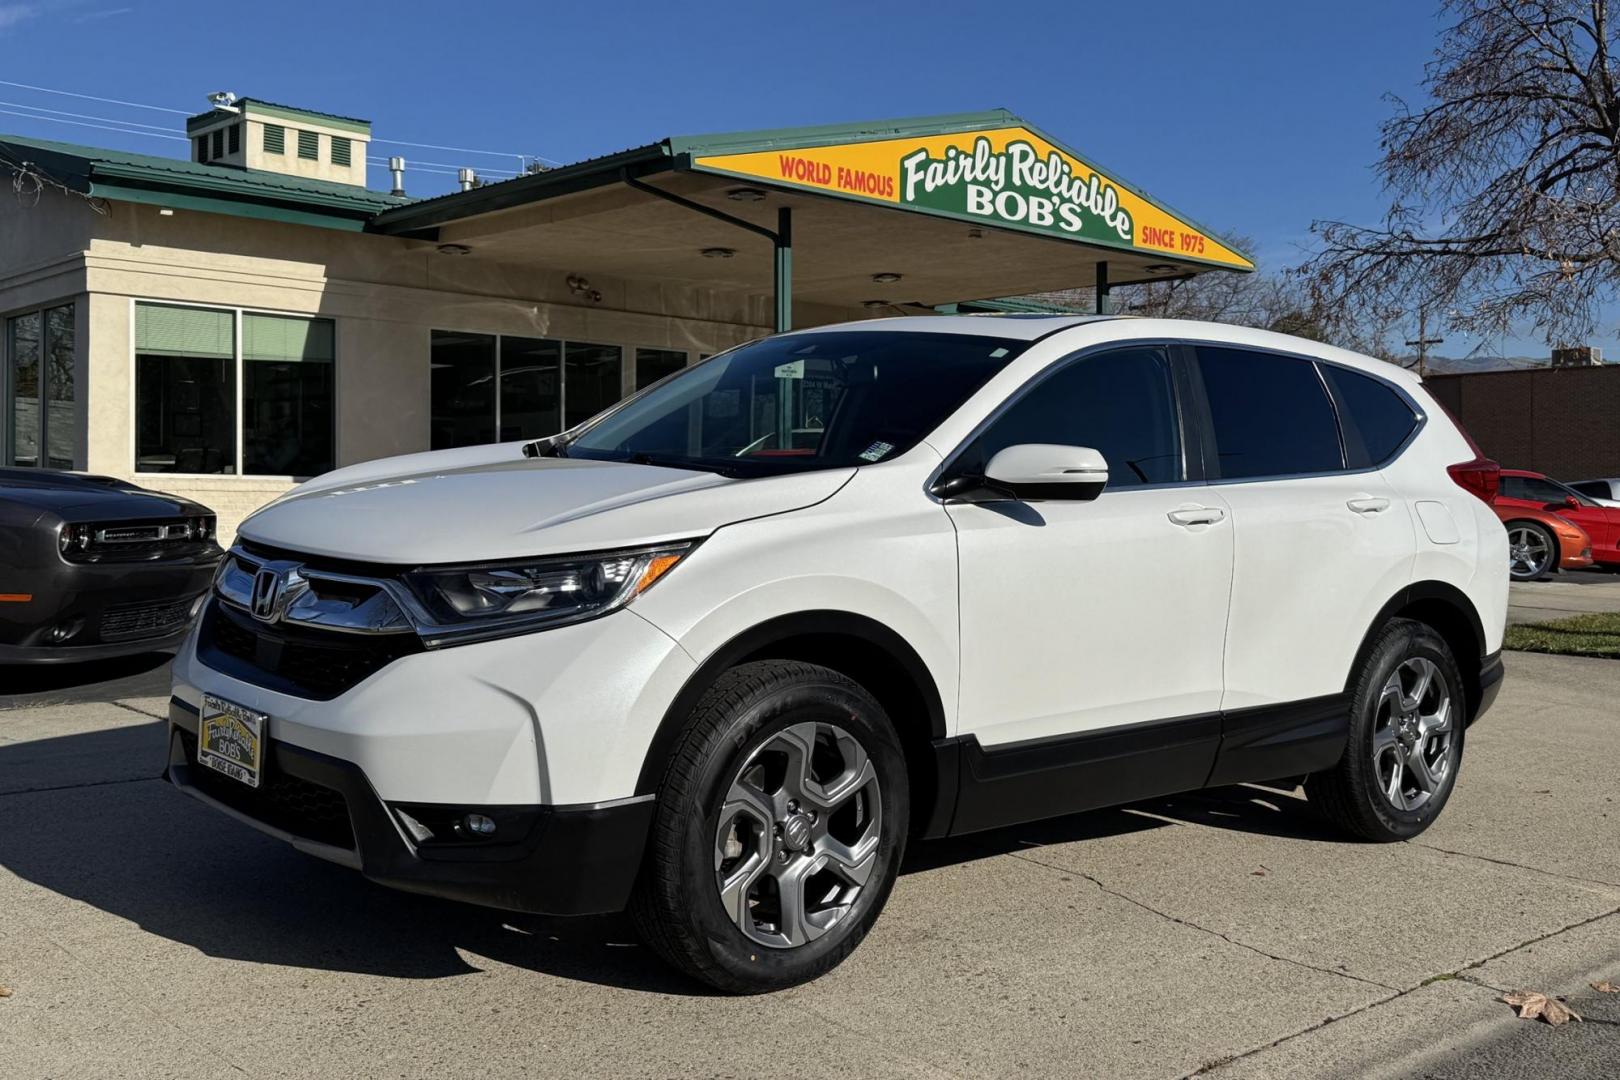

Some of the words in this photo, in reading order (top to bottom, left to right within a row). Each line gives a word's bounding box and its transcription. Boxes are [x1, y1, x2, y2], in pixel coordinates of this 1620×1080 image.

[779, 154, 831, 185] WORLD
[837, 167, 893, 197] FAMOUS
[904, 138, 1006, 202] Fairly
[1009, 142, 1131, 240] Reliable
[967, 184, 1083, 232] BOB'S
[1142, 226, 1175, 249] SINCE
[1180, 233, 1204, 254] 1975
[219, 740, 240, 760] BOB'S
